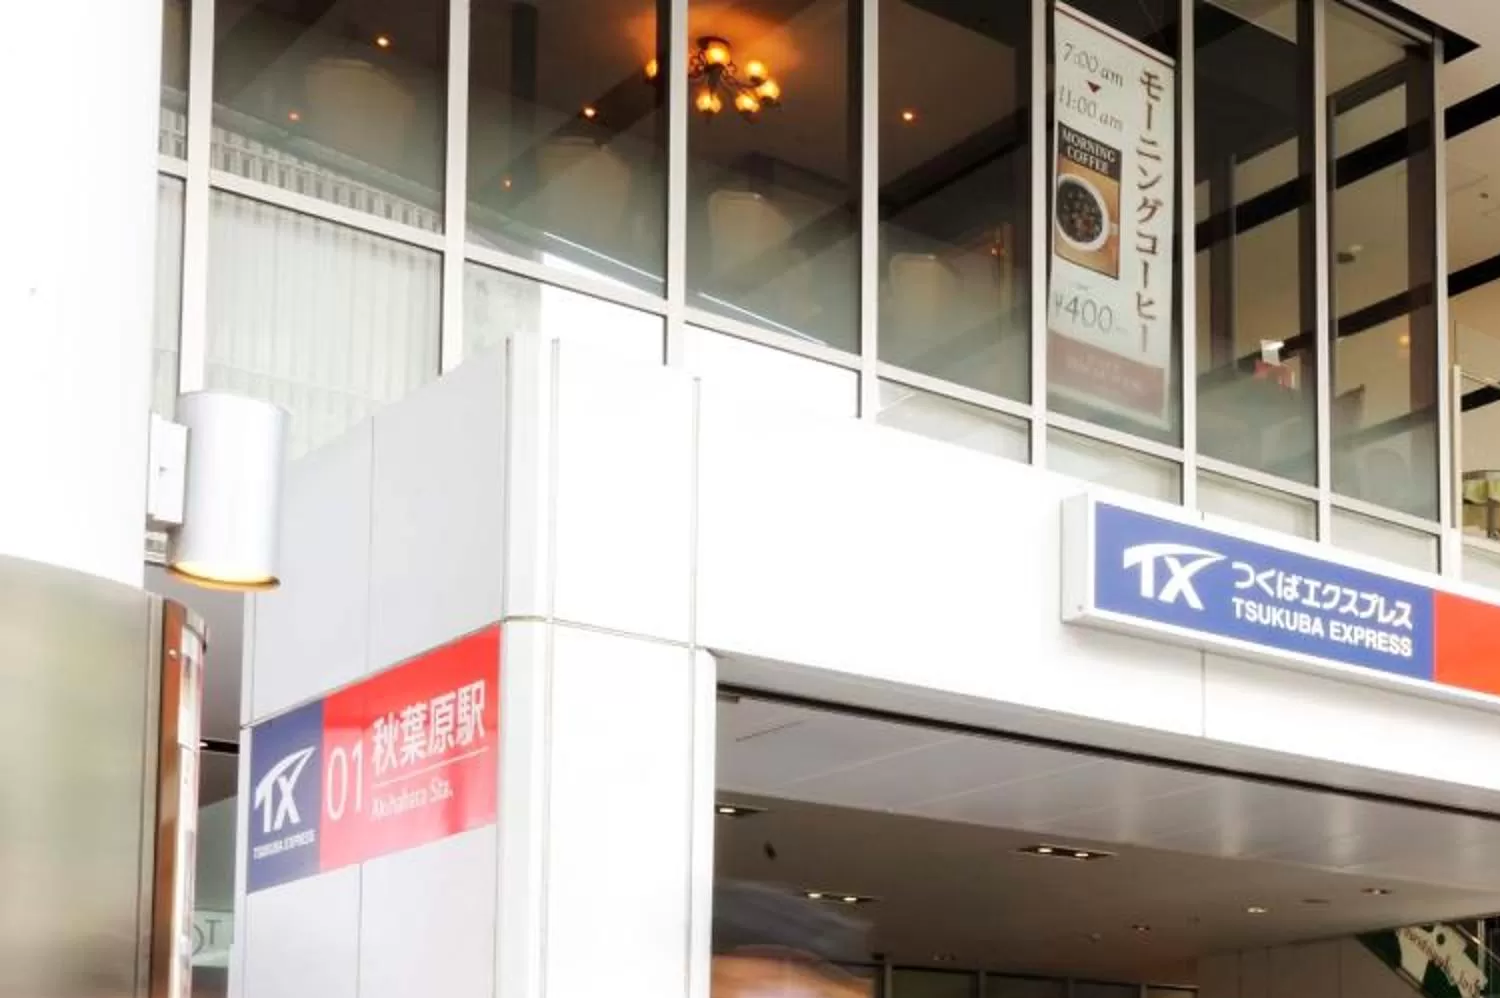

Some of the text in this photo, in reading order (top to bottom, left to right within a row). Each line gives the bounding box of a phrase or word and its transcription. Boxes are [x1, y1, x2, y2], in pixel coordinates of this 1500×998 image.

[1063, 42, 1099, 73] 7:00
[1059, 85, 1097, 118] 11:00
[1063, 129, 1116, 162] MORNING
[1067, 145, 1109, 174] COFFEE
[1136, 70, 1164, 353] モーニングコーヒー
[1123, 542, 1228, 611] TX
[1232, 562, 1413, 630] つくばエクスプレス
[1232, 597, 1413, 657] TSUKUBA EXPRESS
[371, 679, 486, 776] 秋葉原駅
[254, 746, 317, 833] TX
[326, 739, 364, 822] 01
